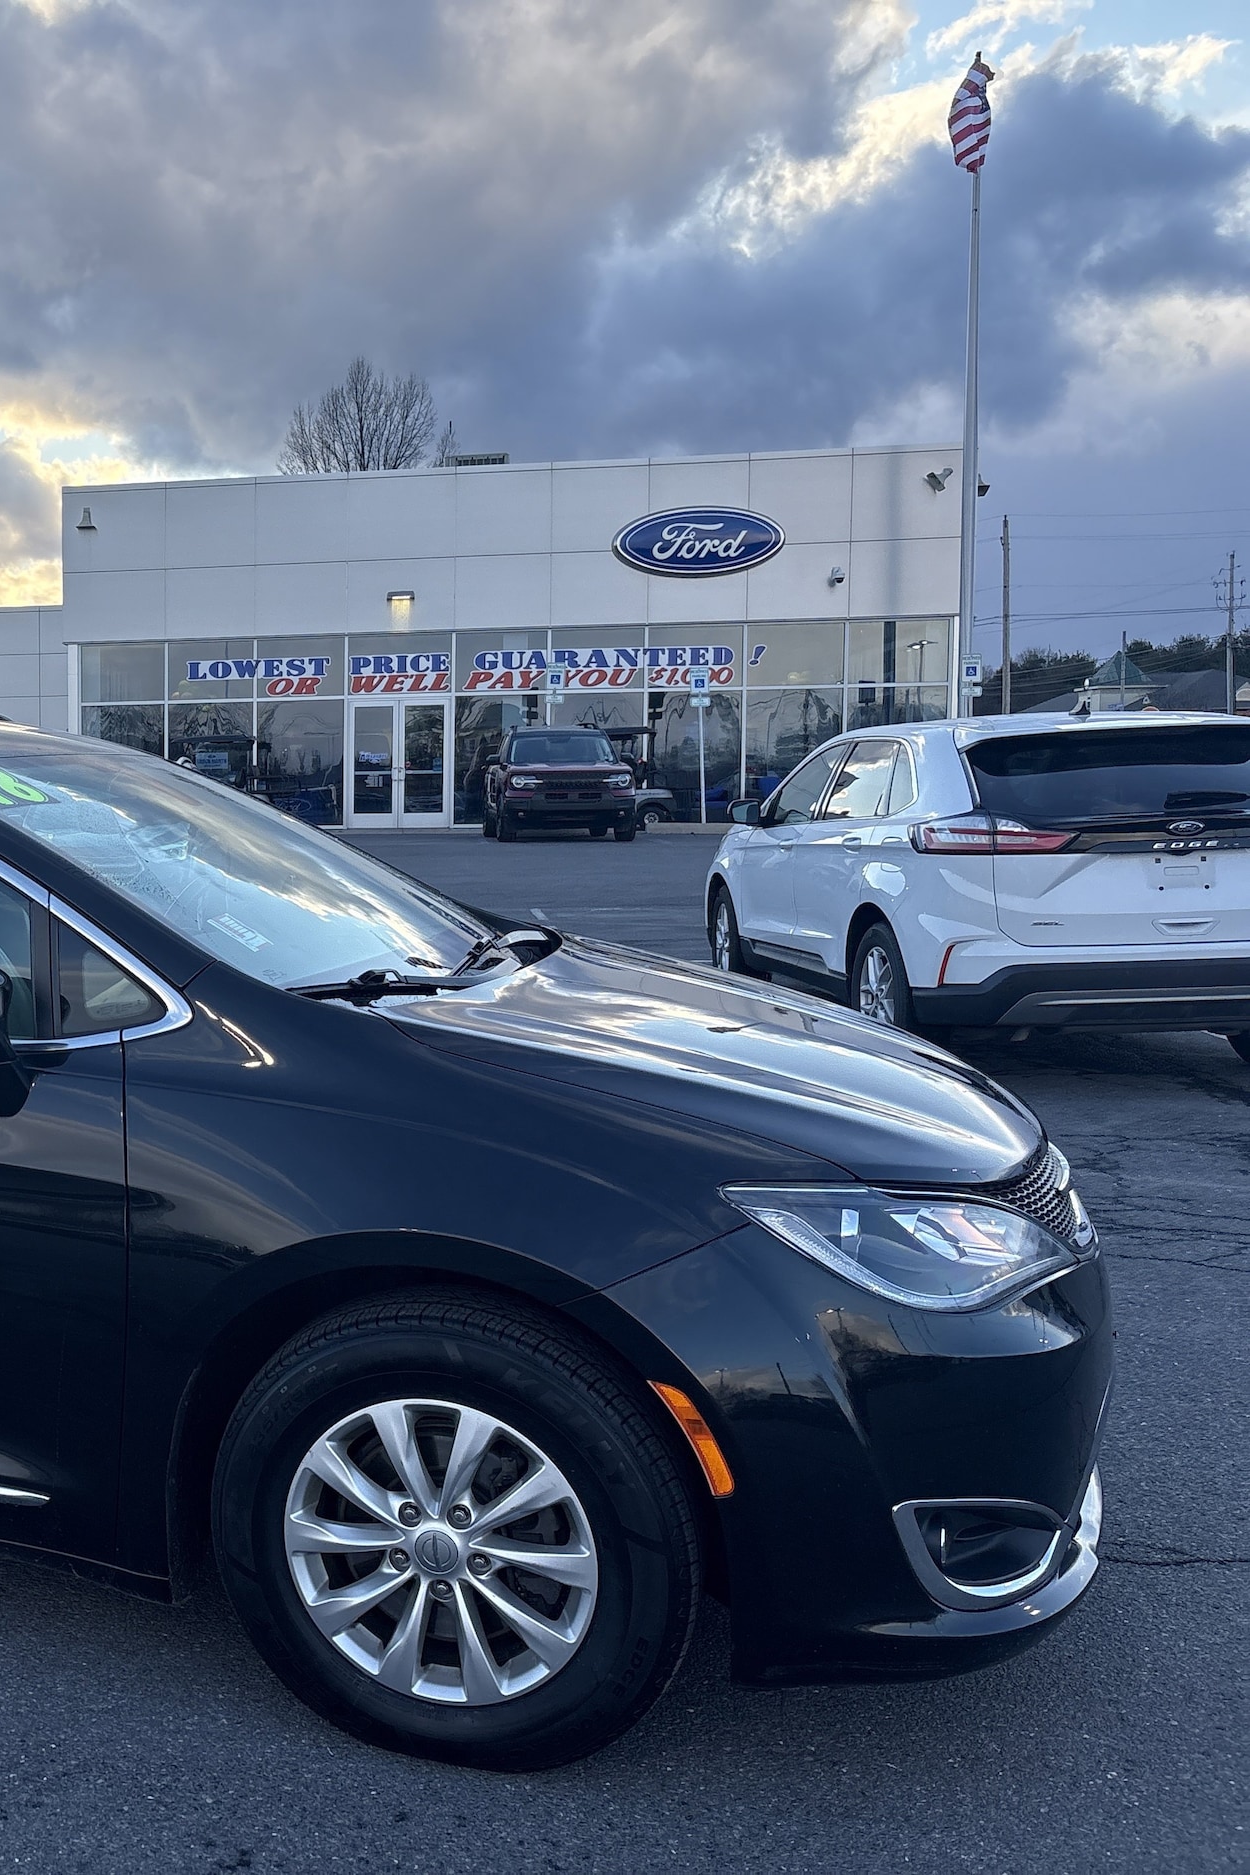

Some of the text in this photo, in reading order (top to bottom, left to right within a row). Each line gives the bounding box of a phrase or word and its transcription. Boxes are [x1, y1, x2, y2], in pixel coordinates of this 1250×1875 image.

[652, 522, 749, 561] Ford
[187, 657, 330, 681] LOWEST
[350, 652, 451, 676] PRICE
[474, 646, 734, 671] GUARANTEED
[267, 677, 321, 696] OR
[351, 673, 450, 694] WE'LL
[463, 670, 546, 690] PAY
[565, 668, 638, 688] YOU
[1151, 839, 1220, 850] EDGE
